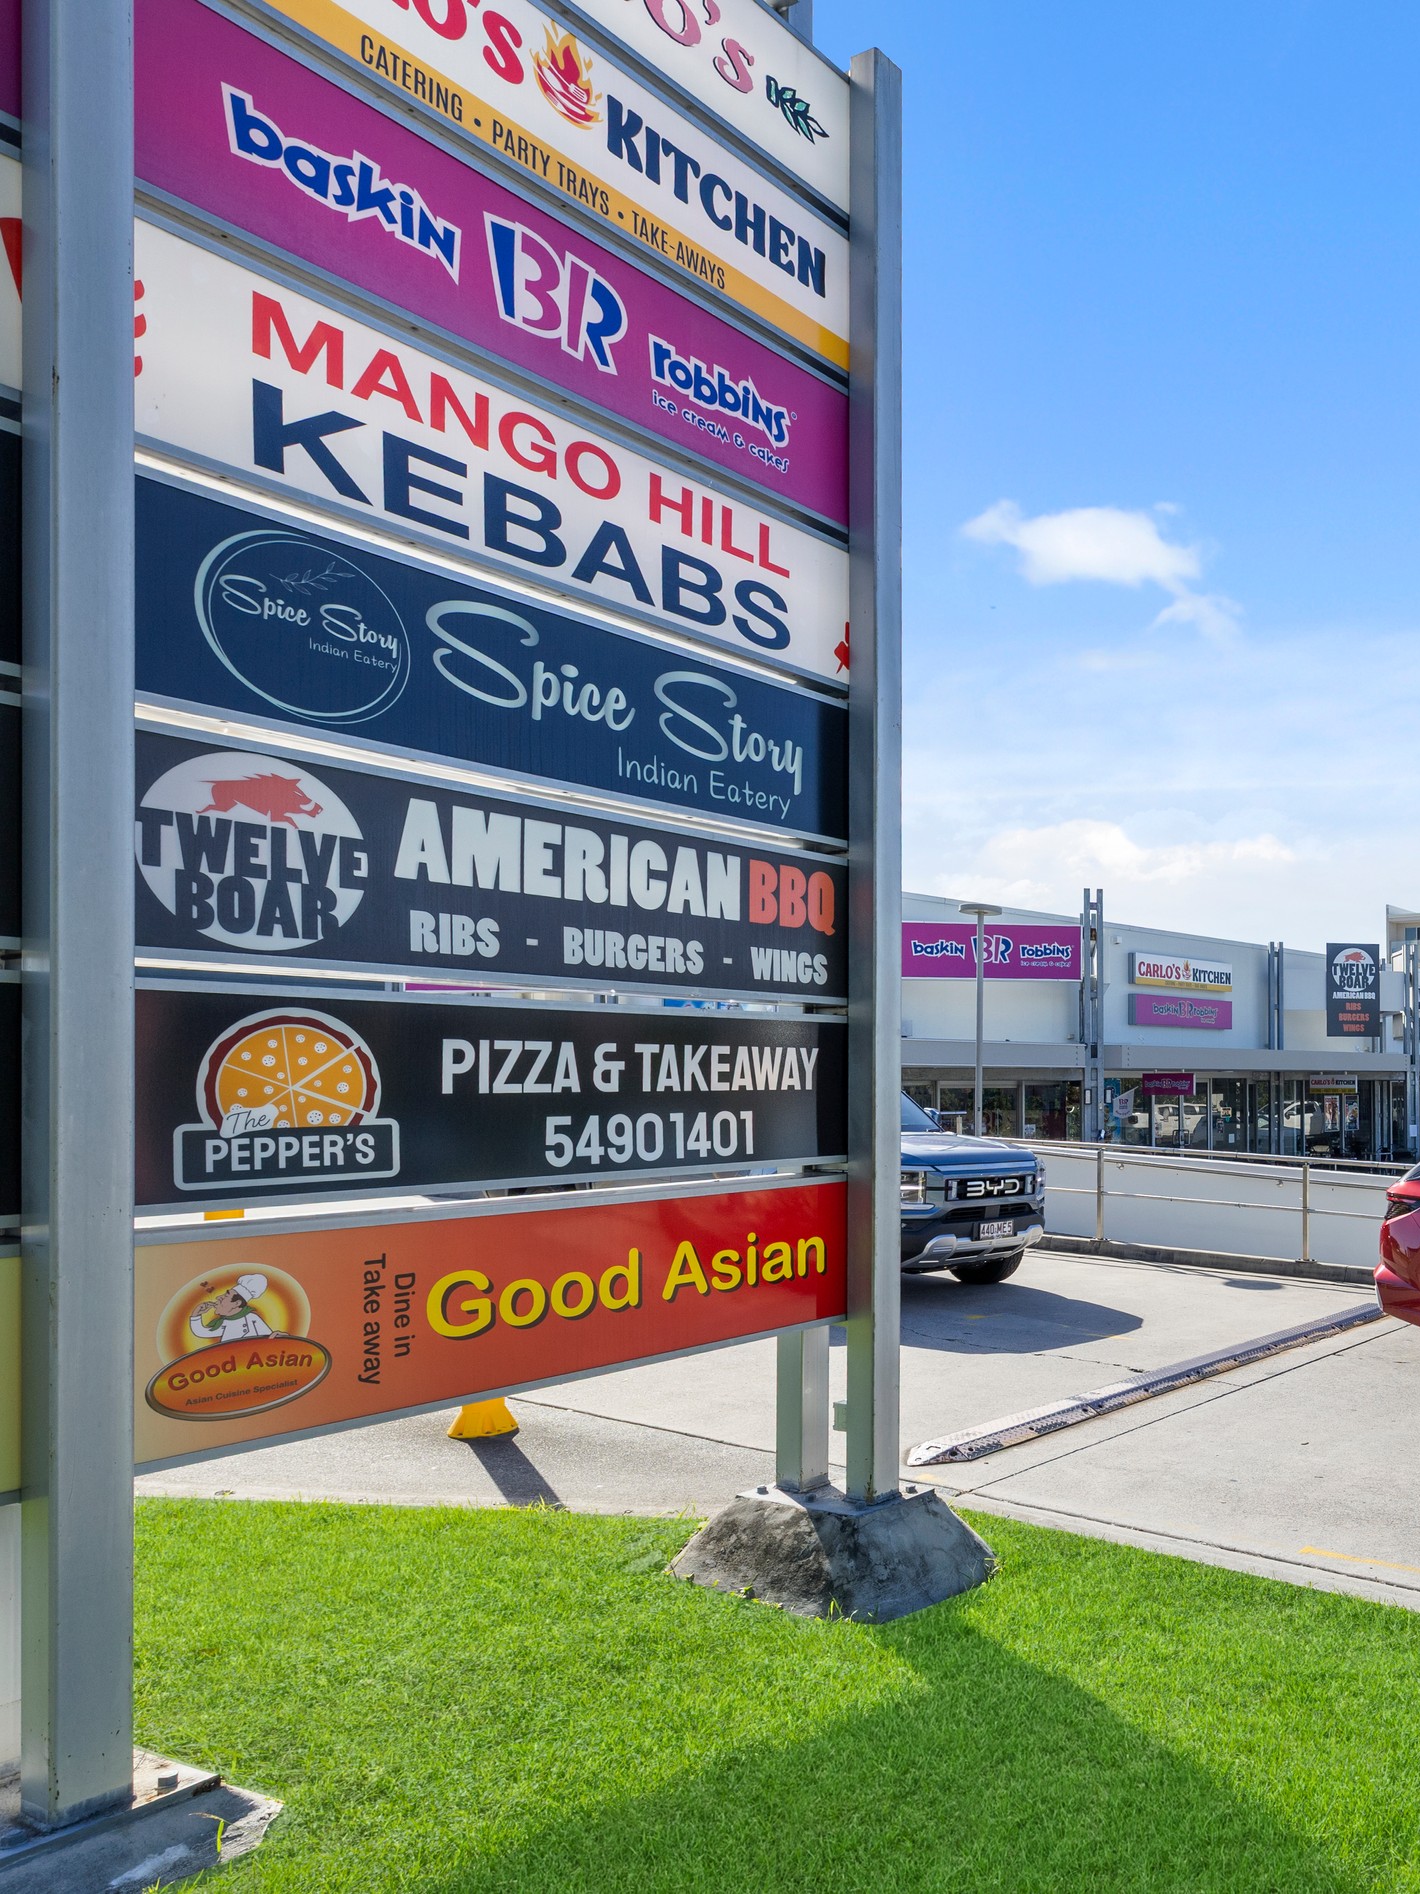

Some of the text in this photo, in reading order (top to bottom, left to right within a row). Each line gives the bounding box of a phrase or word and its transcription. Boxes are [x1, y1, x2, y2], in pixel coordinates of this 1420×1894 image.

[361, 34, 725, 290] CATERING PARTY TRAYS TAKE-AWAYS
[606, 94, 826, 298] KITCHEN
[484, 211, 628, 375] BR
[252, 290, 791, 579] MANGO HILL
[652, 390, 678, 417] ice
[734, 432, 745, 448] &
[749, 442, 790, 473] cakes
[252, 378, 792, 651] KEBABS
[219, 574, 398, 659] Spice Story
[309, 636, 398, 673] Indian Eatery
[425, 600, 803, 795] Spice Story
[617, 746, 792, 820] Indian Eatery
[135, 805, 369, 891] TWELVE
[394, 797, 836, 936] AMERICAN BBQ
[175, 868, 341, 941] BOAR
[410, 910, 500, 958] RIBS
[563, 926, 704, 975] BURGERS
[750, 946, 829, 986] WINGS
[971, 934, 1013, 964] BR
[1138, 961, 1181, 980] CARLO'S
[1192, 968, 1231, 985] KITCHEN
[1332, 963, 1375, 976] TWELVE
[1333, 991, 1375, 1000] AMERICAN BBQ
[1339, 975, 1369, 989] BOAR
[1345, 1002, 1362, 1010] RIBS
[1338, 1013, 1370, 1021] BURGERS
[1343, 1024, 1365, 1032] WINGS
[441, 1038, 820, 1094] PIZZA & TAKEAWAY
[205, 1133, 375, 1173] PEPPER'S
[226, 1109, 271, 1134] The
[544, 1110, 756, 1169] 54901401
[966, 1179, 1020, 1196] BYD
[358, 1253, 386, 1385] Take away
[394, 1272, 416, 1358] Dine in
[426, 1234, 827, 1338] Good Asian
[167, 1351, 313, 1391] Good Asian
[185, 1379, 298, 1406] Asian Cuisine Specialist
